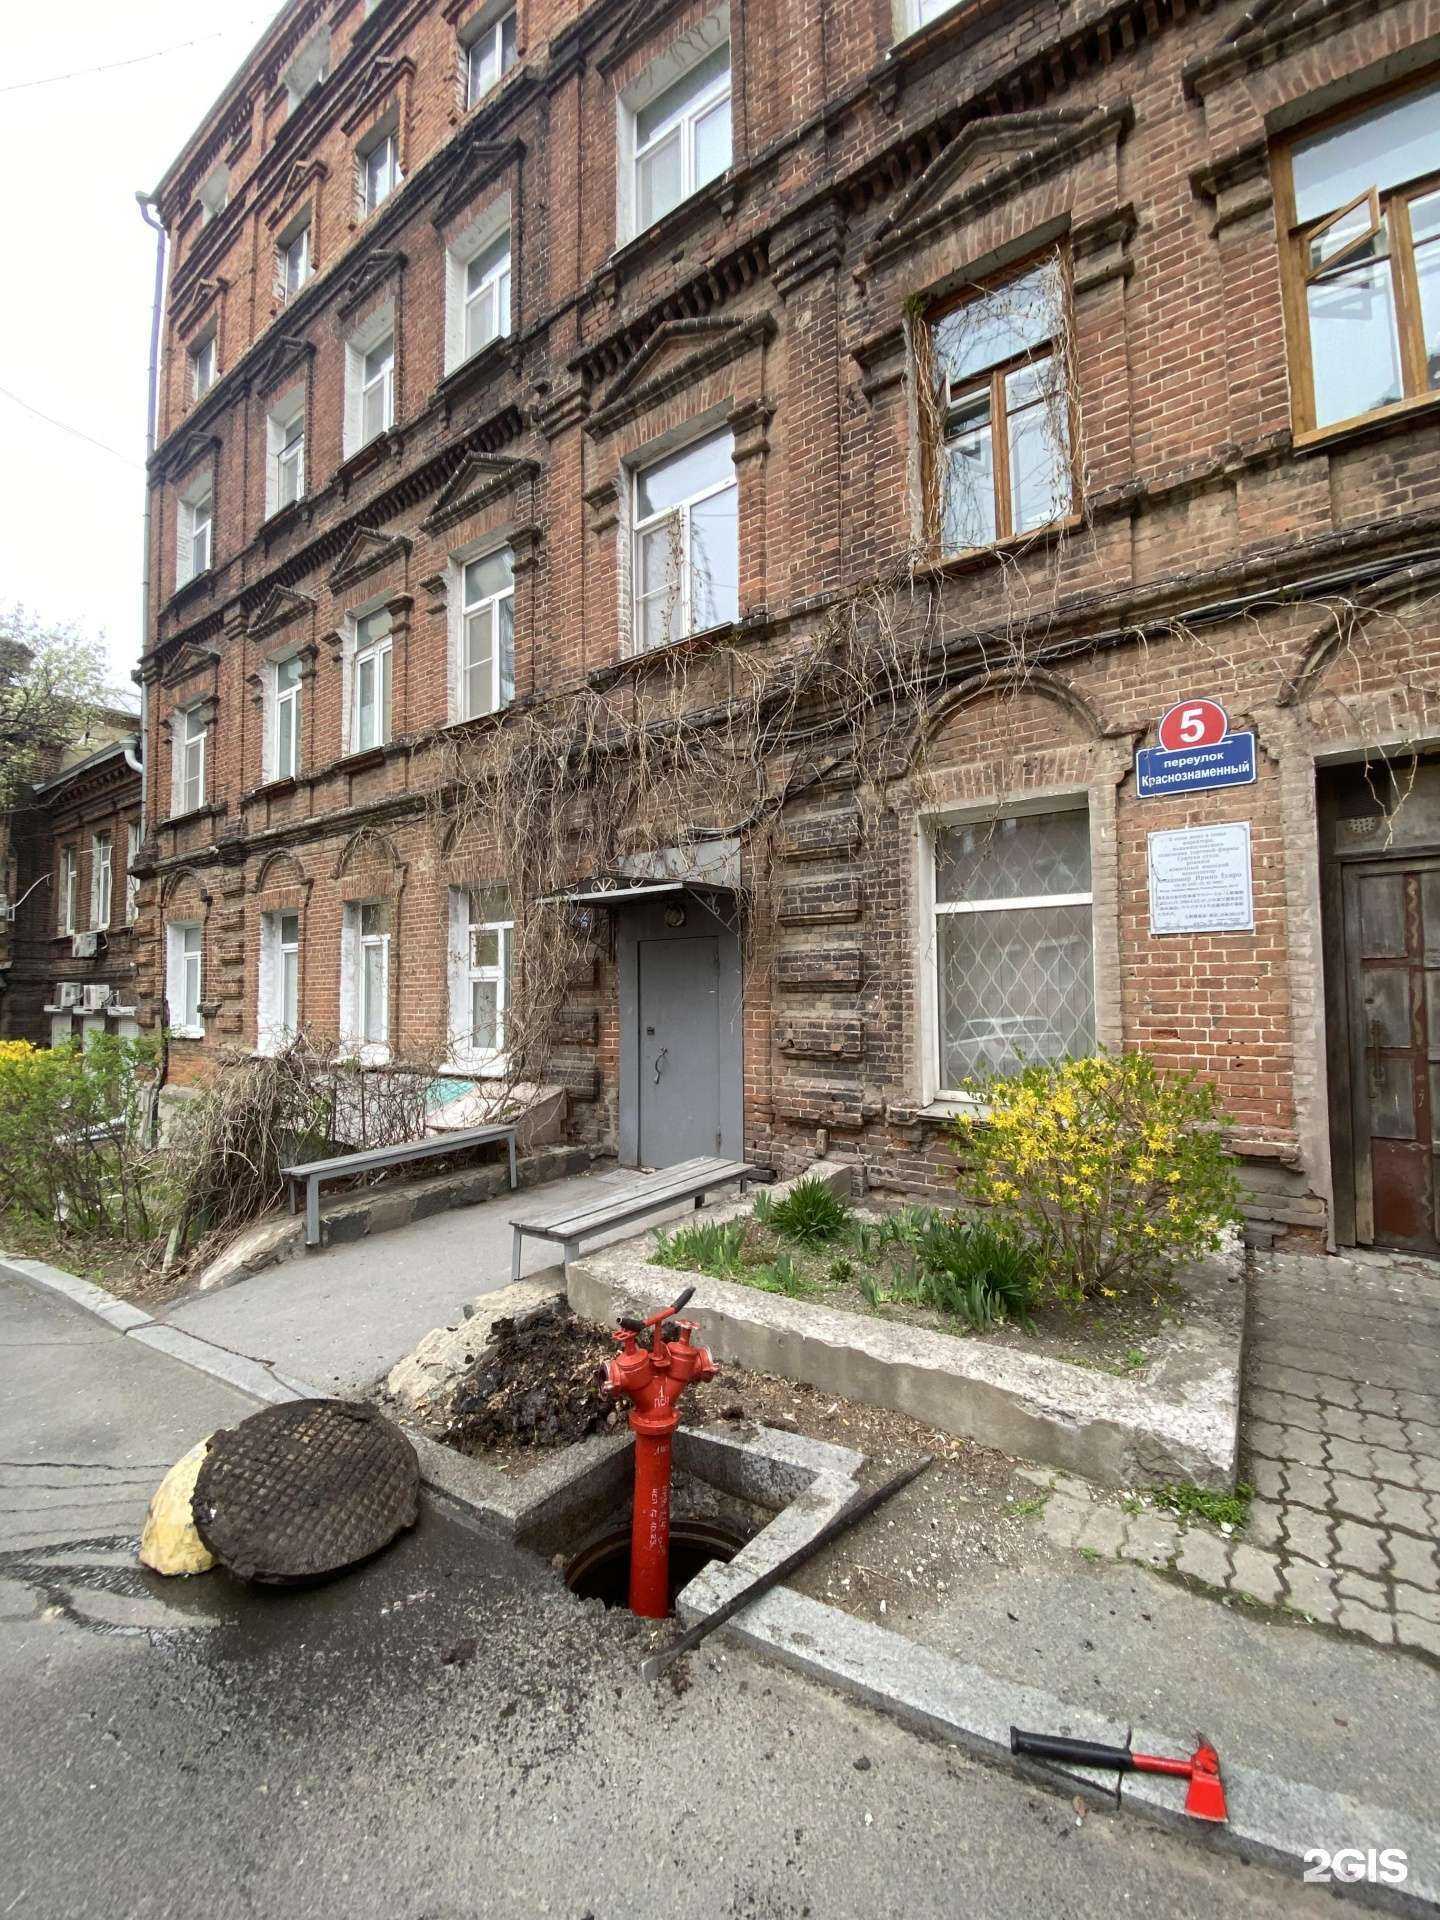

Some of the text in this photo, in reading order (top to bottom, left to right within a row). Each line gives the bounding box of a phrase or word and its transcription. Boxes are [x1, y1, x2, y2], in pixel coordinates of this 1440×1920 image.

[1180, 708, 1205, 742] 5
[1142, 760, 1249, 787] Краснознаменный
[1164, 752, 1224, 768] переулок
